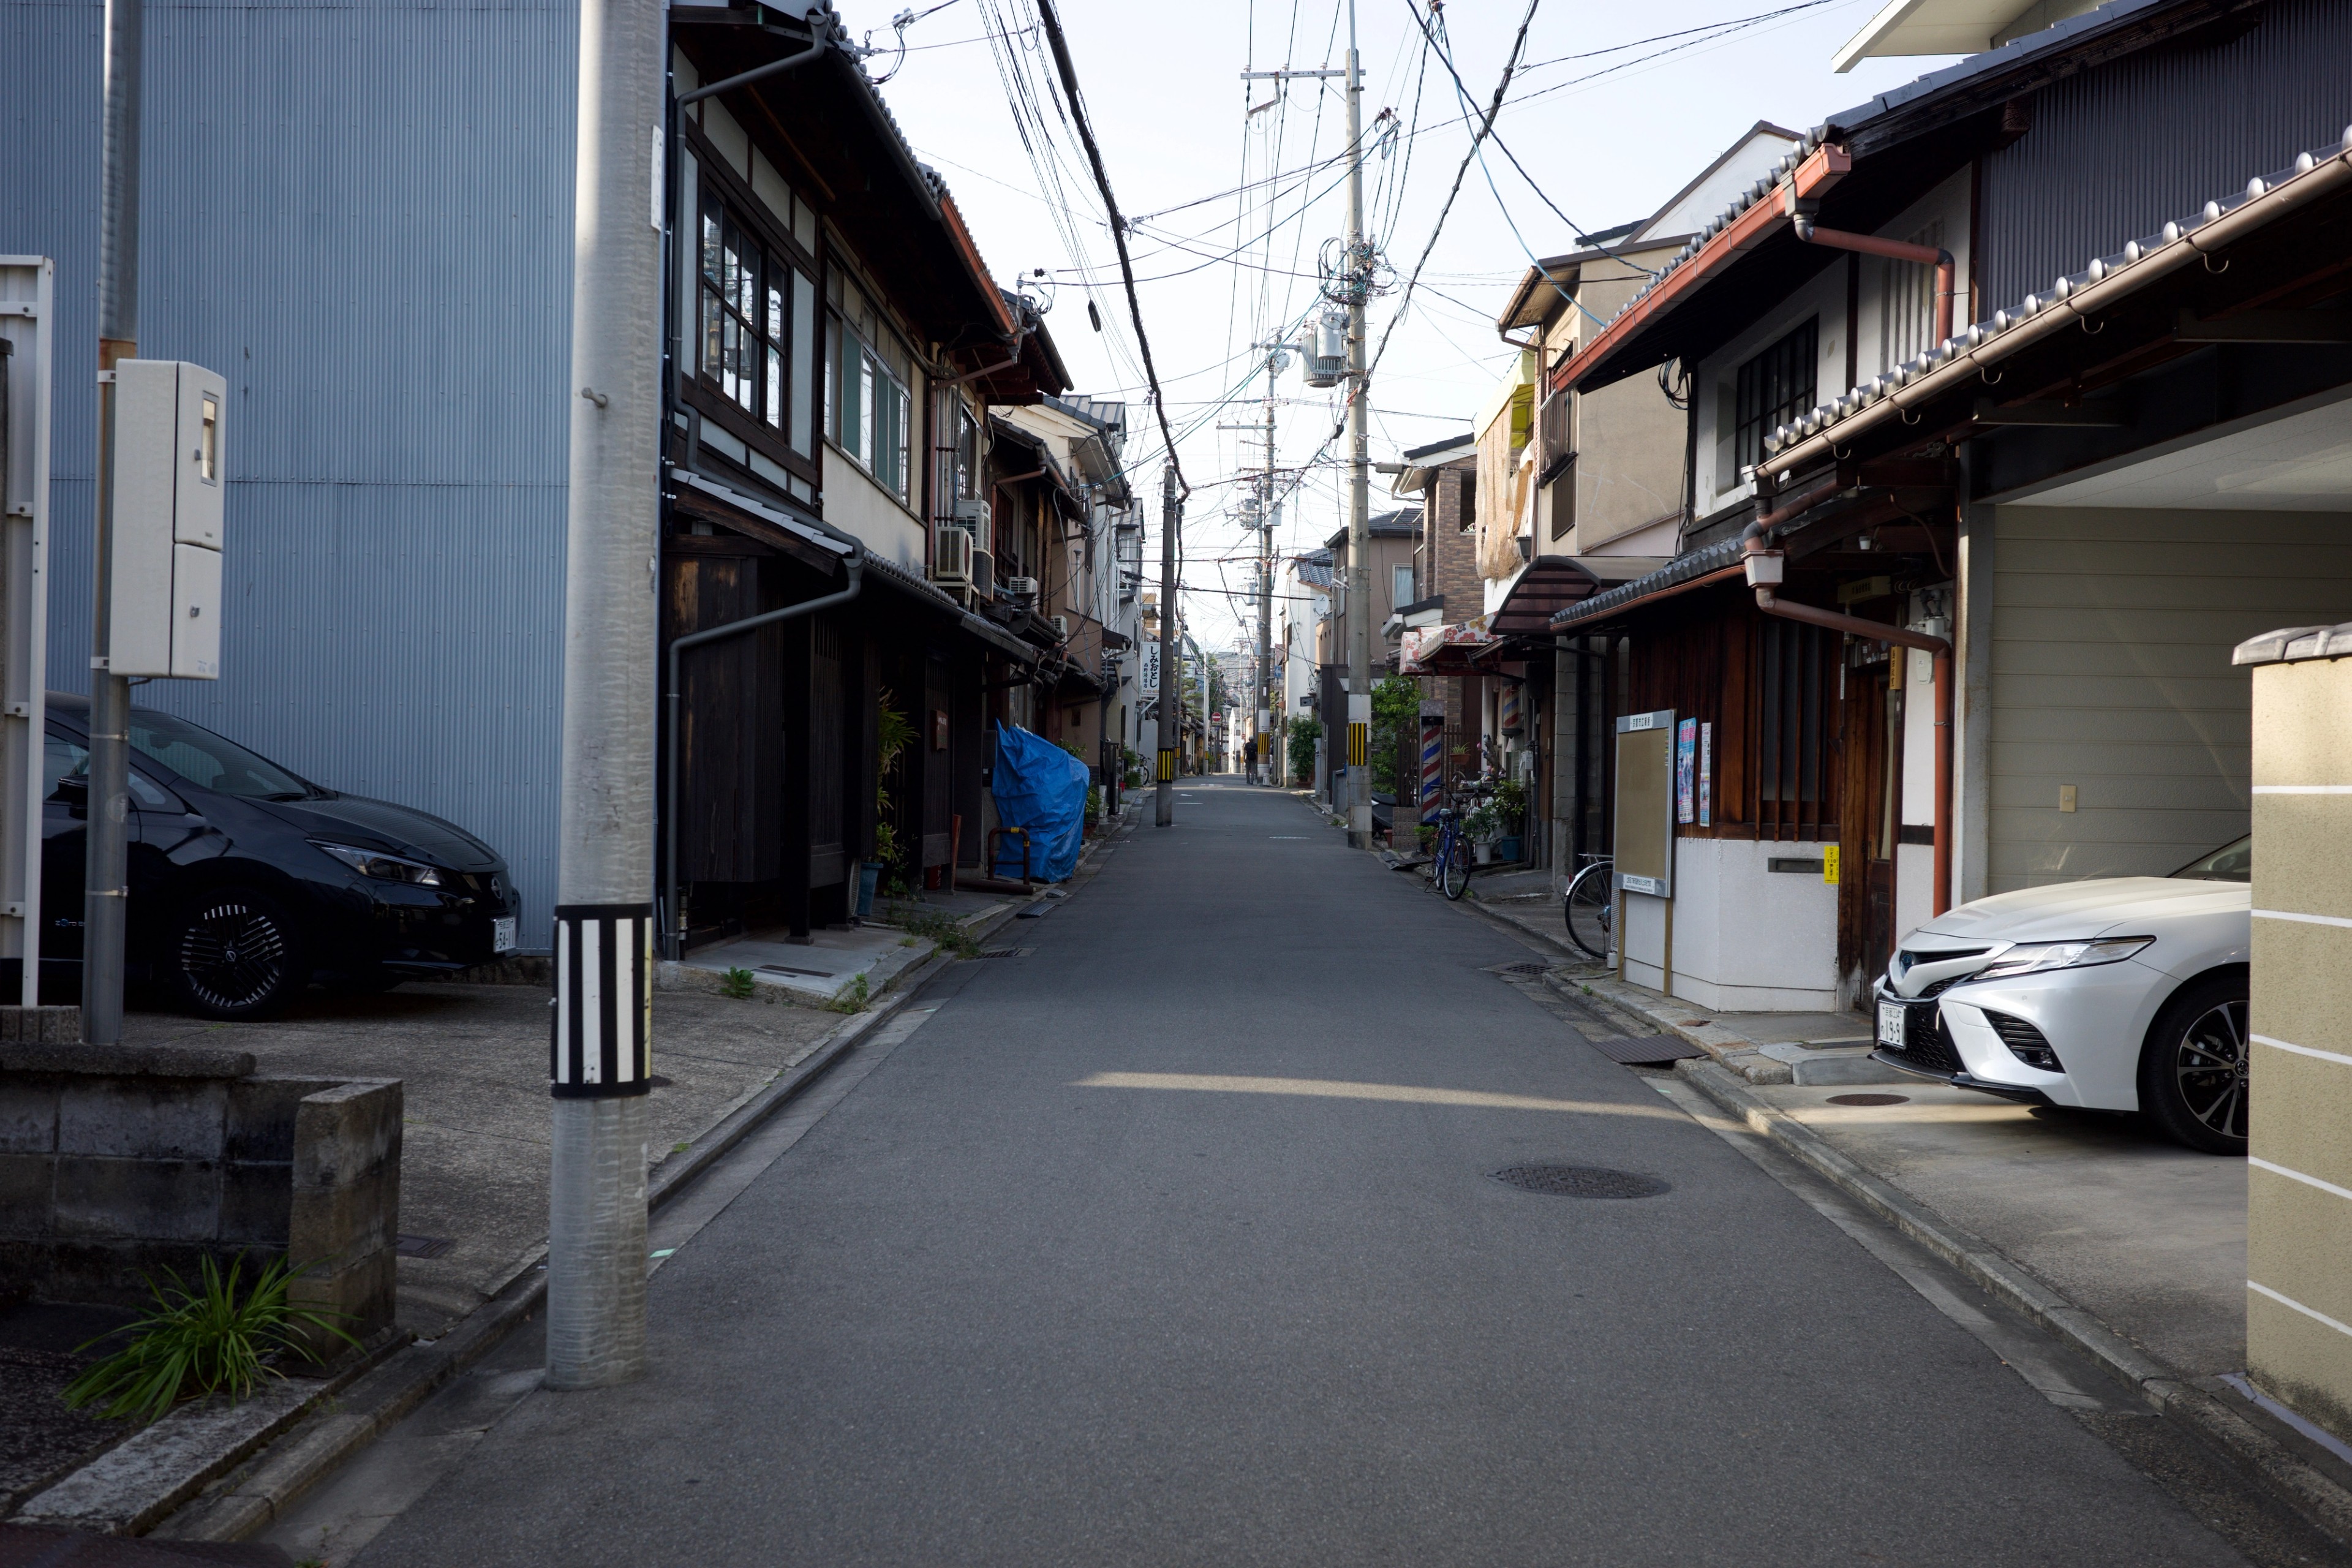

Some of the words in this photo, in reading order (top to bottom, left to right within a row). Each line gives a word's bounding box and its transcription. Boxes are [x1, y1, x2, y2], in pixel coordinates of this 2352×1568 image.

[1150, 646, 1159, 688] しみおとし
